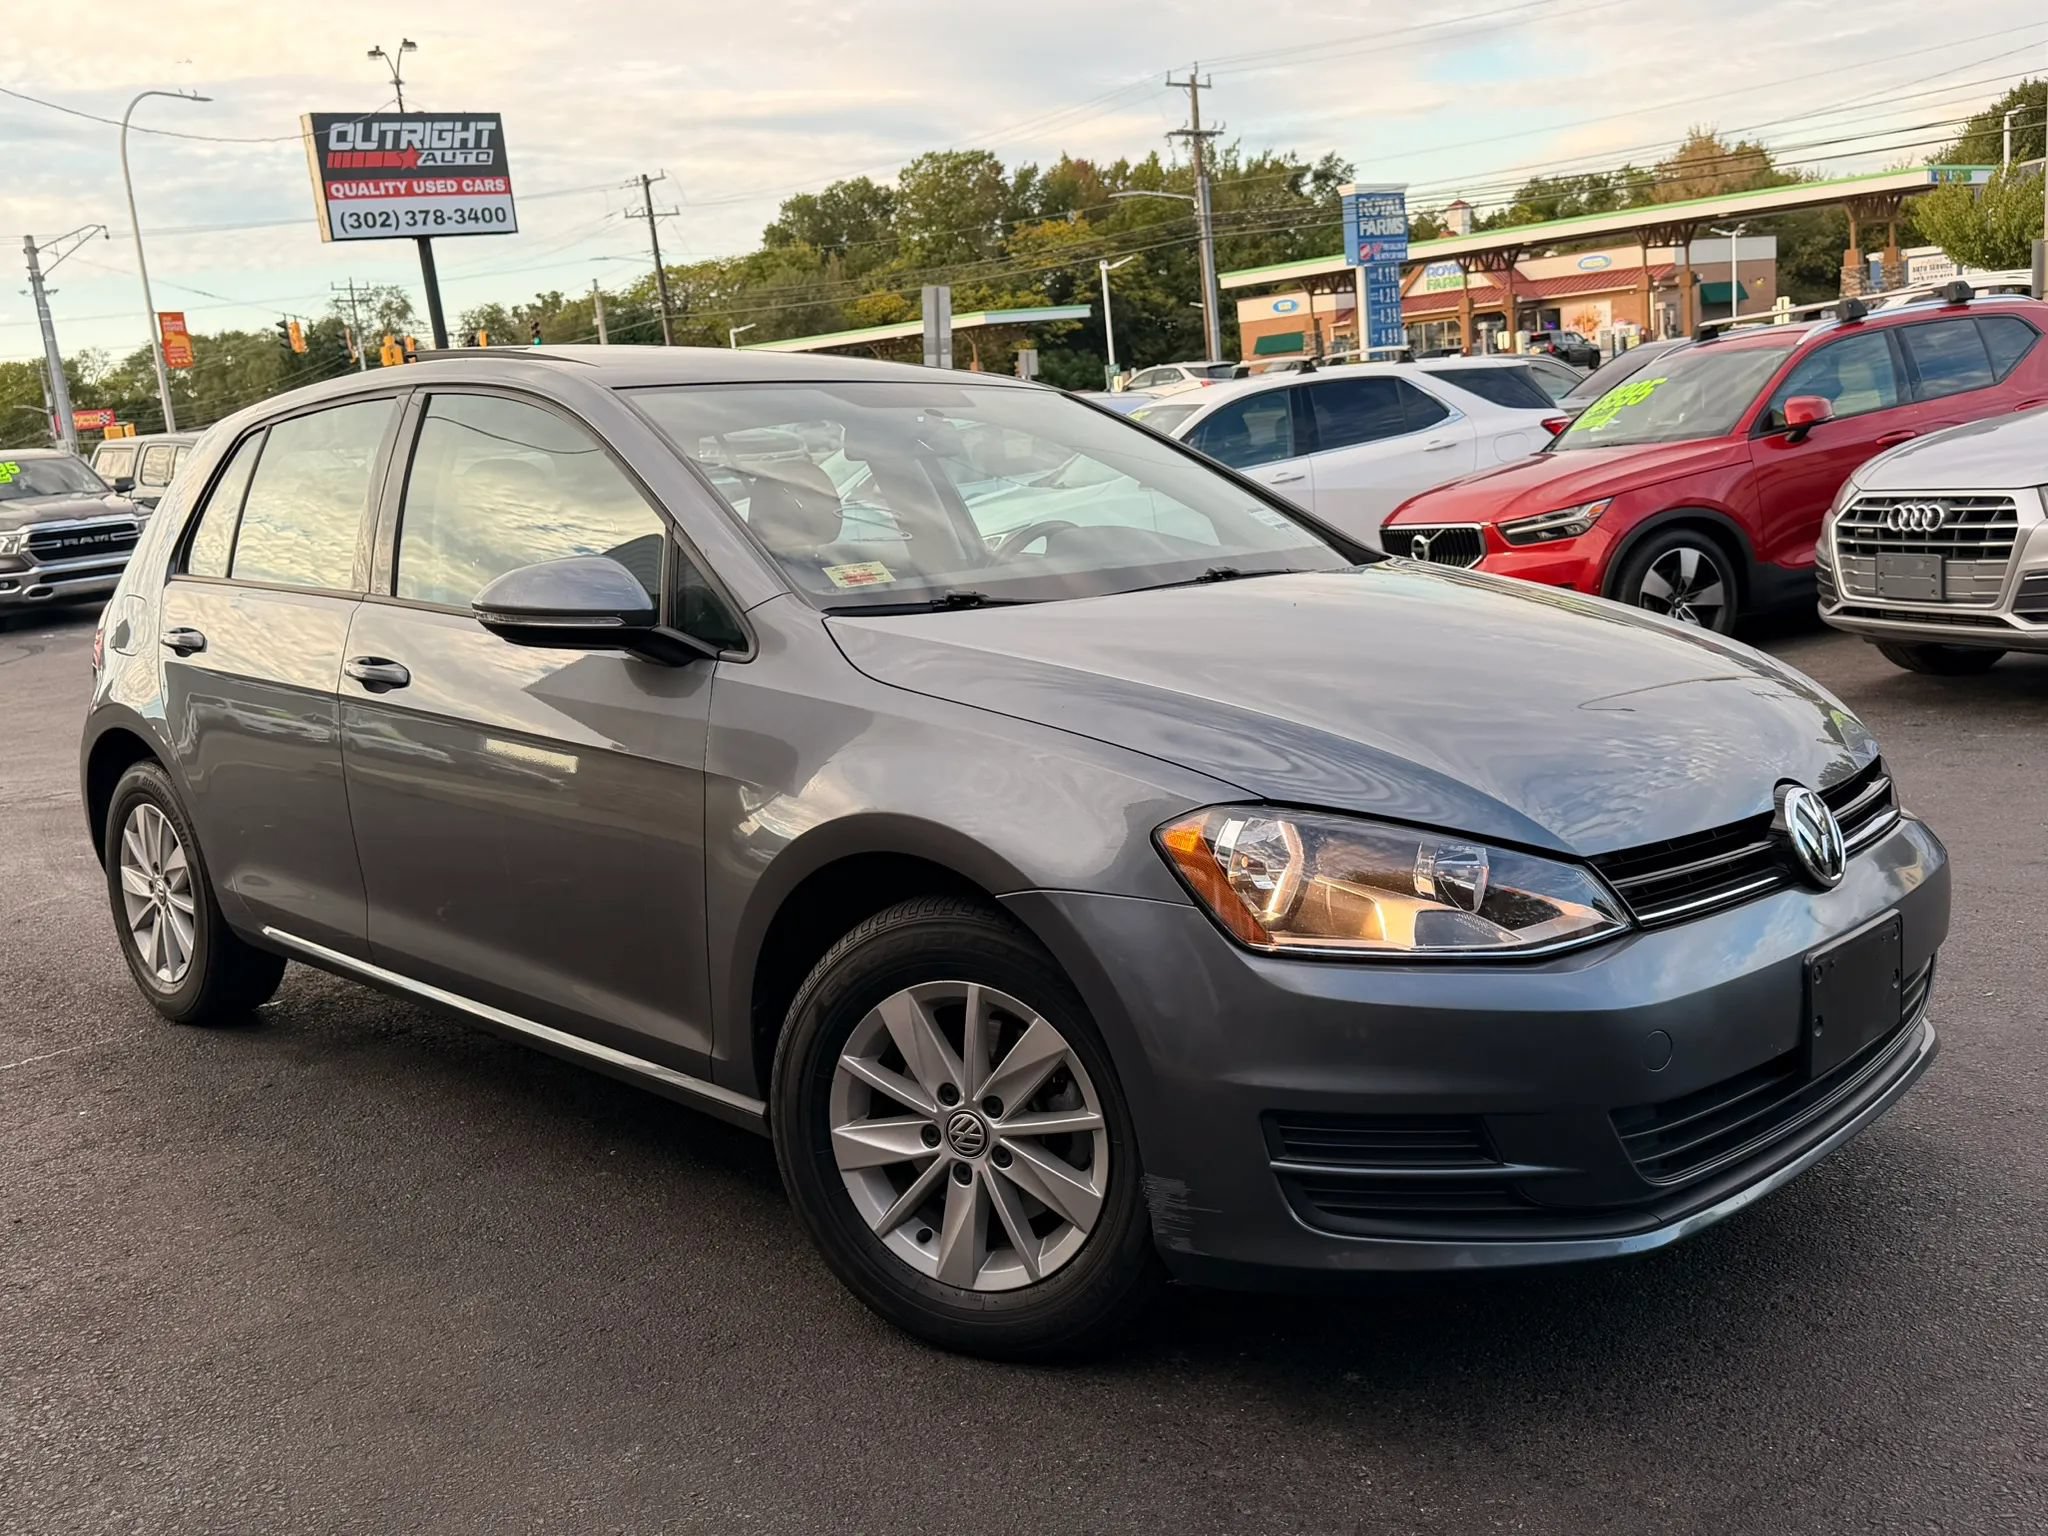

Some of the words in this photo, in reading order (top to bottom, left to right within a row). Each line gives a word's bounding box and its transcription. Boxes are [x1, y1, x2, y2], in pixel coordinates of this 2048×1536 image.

[328, 121, 497, 151] OUTRIGHT
[421, 151, 491, 164] AUTO
[330, 181, 408, 198] QUALITY
[412, 180, 458, 194] USED
[462, 178, 506, 193] CARS
[1358, 197, 1404, 217] ROYAL
[1359, 217, 1405, 236] FARMS
[63, 534, 109, 547] RAM
[141, 776, 191, 849] BRIDGESTONE
